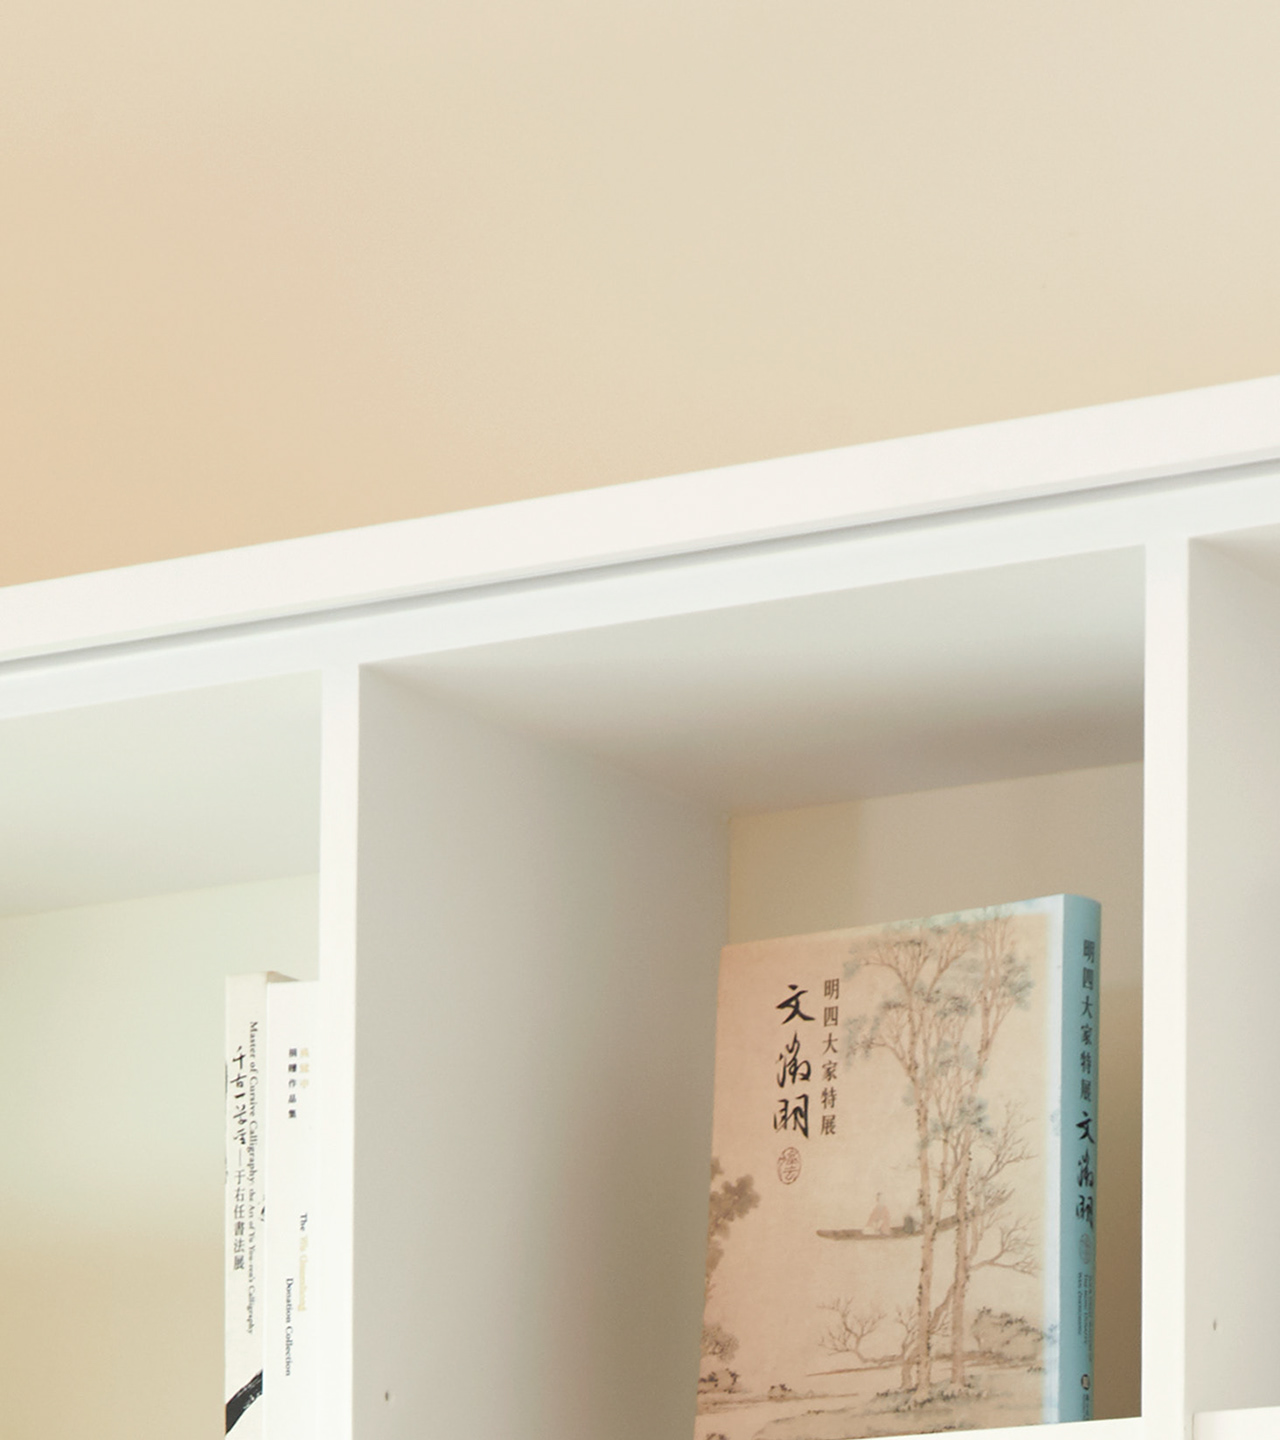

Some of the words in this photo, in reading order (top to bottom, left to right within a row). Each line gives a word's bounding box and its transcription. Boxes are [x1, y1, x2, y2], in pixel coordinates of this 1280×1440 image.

[249, 1021, 258, 1059] Master
[1080, 939, 1096, 1103] 明四大家特展
[249, 1062, 258, 1073] of
[820, 978, 841, 1136] 明四大家特展
[249, 1076, 258, 1118] Cursive
[299, 1213, 309, 1231] The
[285, 1278, 295, 1324] Donation
[285, 1326, 295, 1376] Collection
